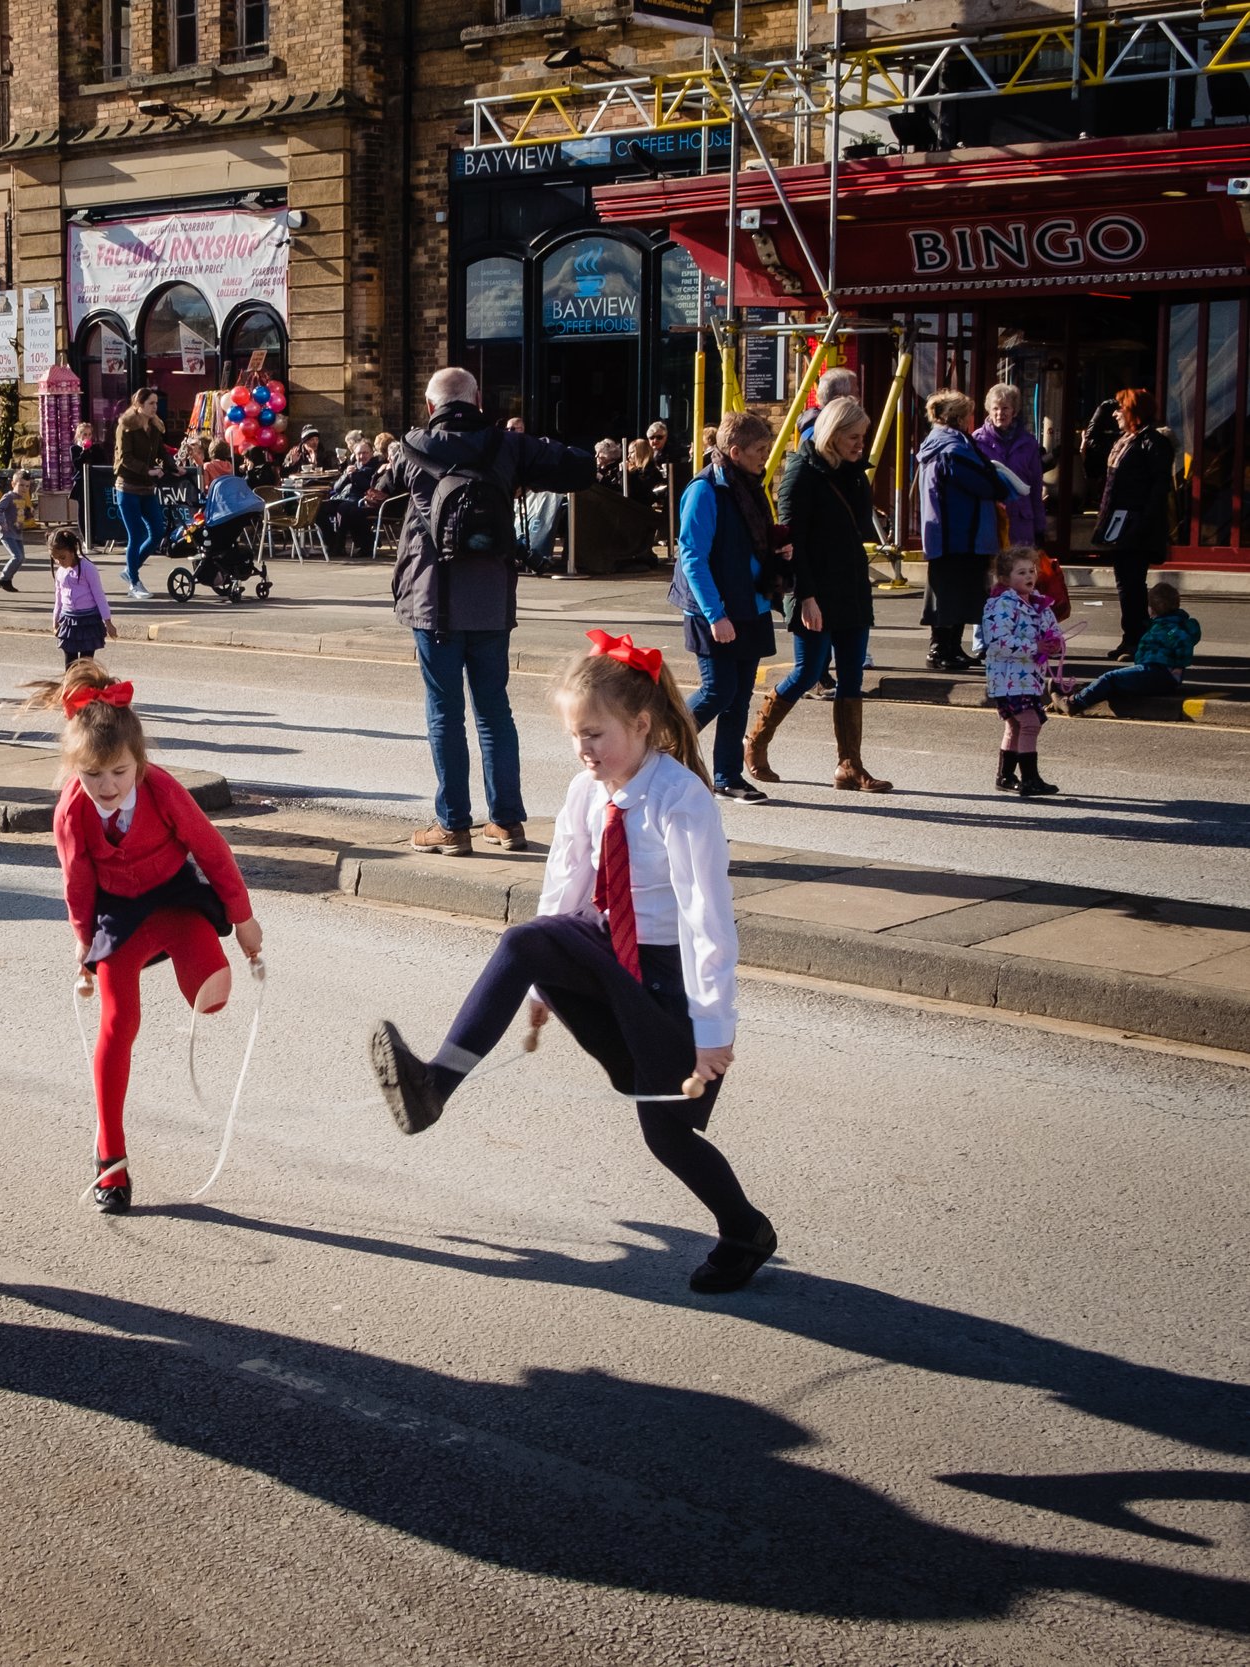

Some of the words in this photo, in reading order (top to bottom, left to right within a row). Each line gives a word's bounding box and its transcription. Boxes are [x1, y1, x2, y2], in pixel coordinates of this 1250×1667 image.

[615, 135, 675, 157] COFFEE
[678, 129, 732, 151] HOUSE
[455, 154, 464, 176] THE
[464, 144, 557, 176] BAYVIEW
[96, 238, 166, 267] FACTORY
[169, 233, 260, 261] ROCKSHOP
[908, 215, 1146, 273] BINGO
[169, 265, 193, 276] BEATEN
[221, 277, 243, 286] NAMED
[272, 276, 285, 287] BOX
[216, 288, 238, 298] LOLLIES
[683, 285, 716, 293] CHOCLATE
[77, 295, 92, 304] ROCK
[552, 295, 637, 319] BAYVIEW
[39, 328, 50, 336] Our
[545, 319, 591, 335] COFFEE
[595, 317, 637, 332] HOUSE
[30, 352, 48, 363] 10%
[104, 487, 112, 504] THE
